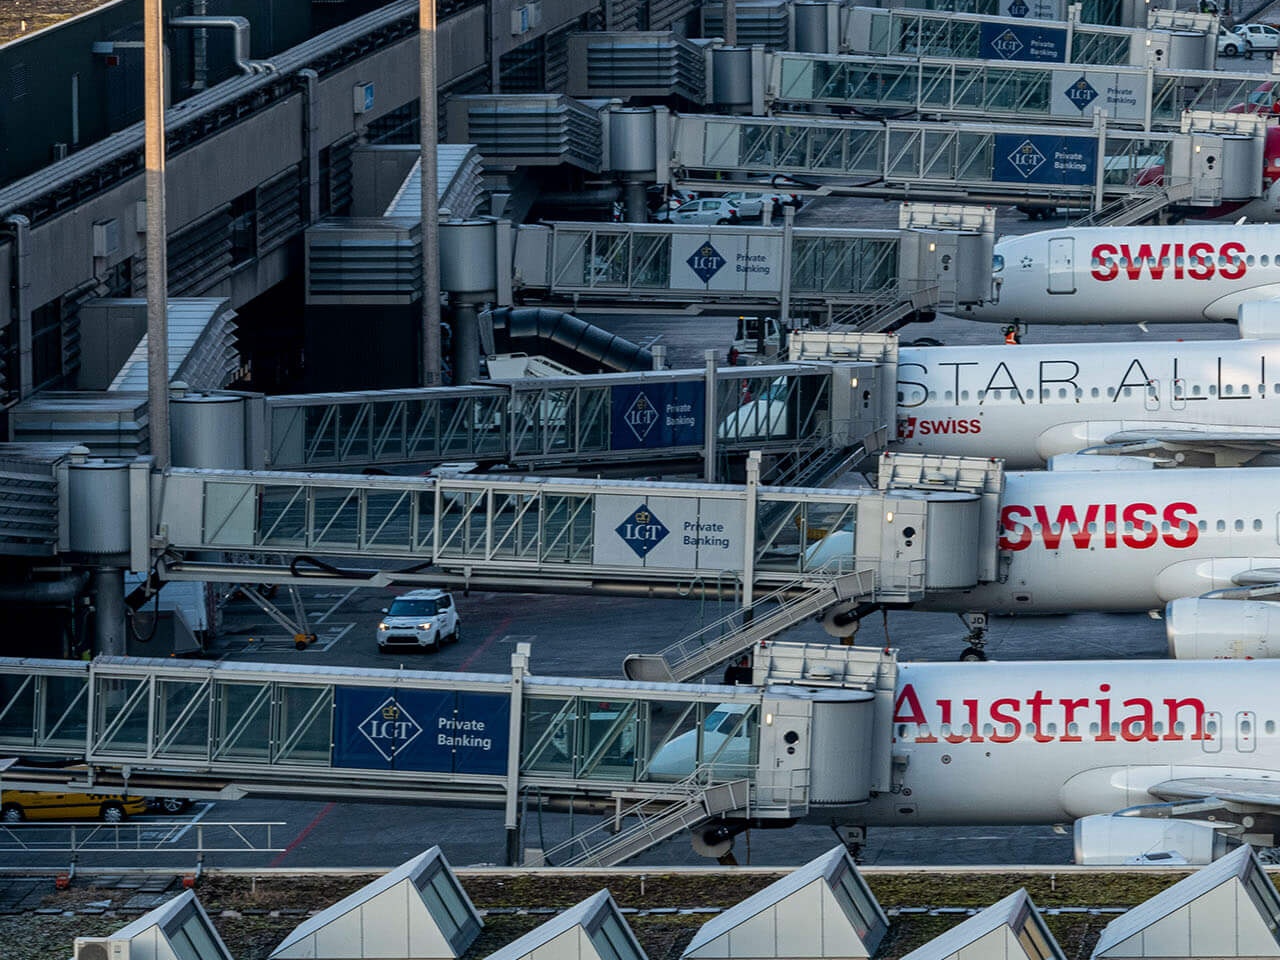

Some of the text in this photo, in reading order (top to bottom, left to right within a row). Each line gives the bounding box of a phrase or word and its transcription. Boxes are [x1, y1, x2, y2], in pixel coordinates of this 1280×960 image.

[1071, 89, 1093, 100] LGT
[1015, 153, 1040, 165] LGT
[1055, 152, 1083, 160] Private
[1055, 162, 1087, 172] Banking
[694, 256, 720, 269] LGT
[736, 254, 767, 262] Private
[1091, 242, 1247, 281] SWISS
[736, 265, 770, 275] Banking
[897, 360, 1079, 407] STAR
[630, 410, 656, 425] LGT
[919, 419, 981, 435] SWISS
[624, 524, 660, 540] LGT
[684, 522, 723, 532] Private
[998, 502, 1199, 551] SWISS
[683, 536, 729, 548] Banking
[892, 683, 1214, 744] Austrian
[371, 721, 412, 739] LGT
[438, 718, 485, 730] Private
[437, 734, 492, 750] Banking
